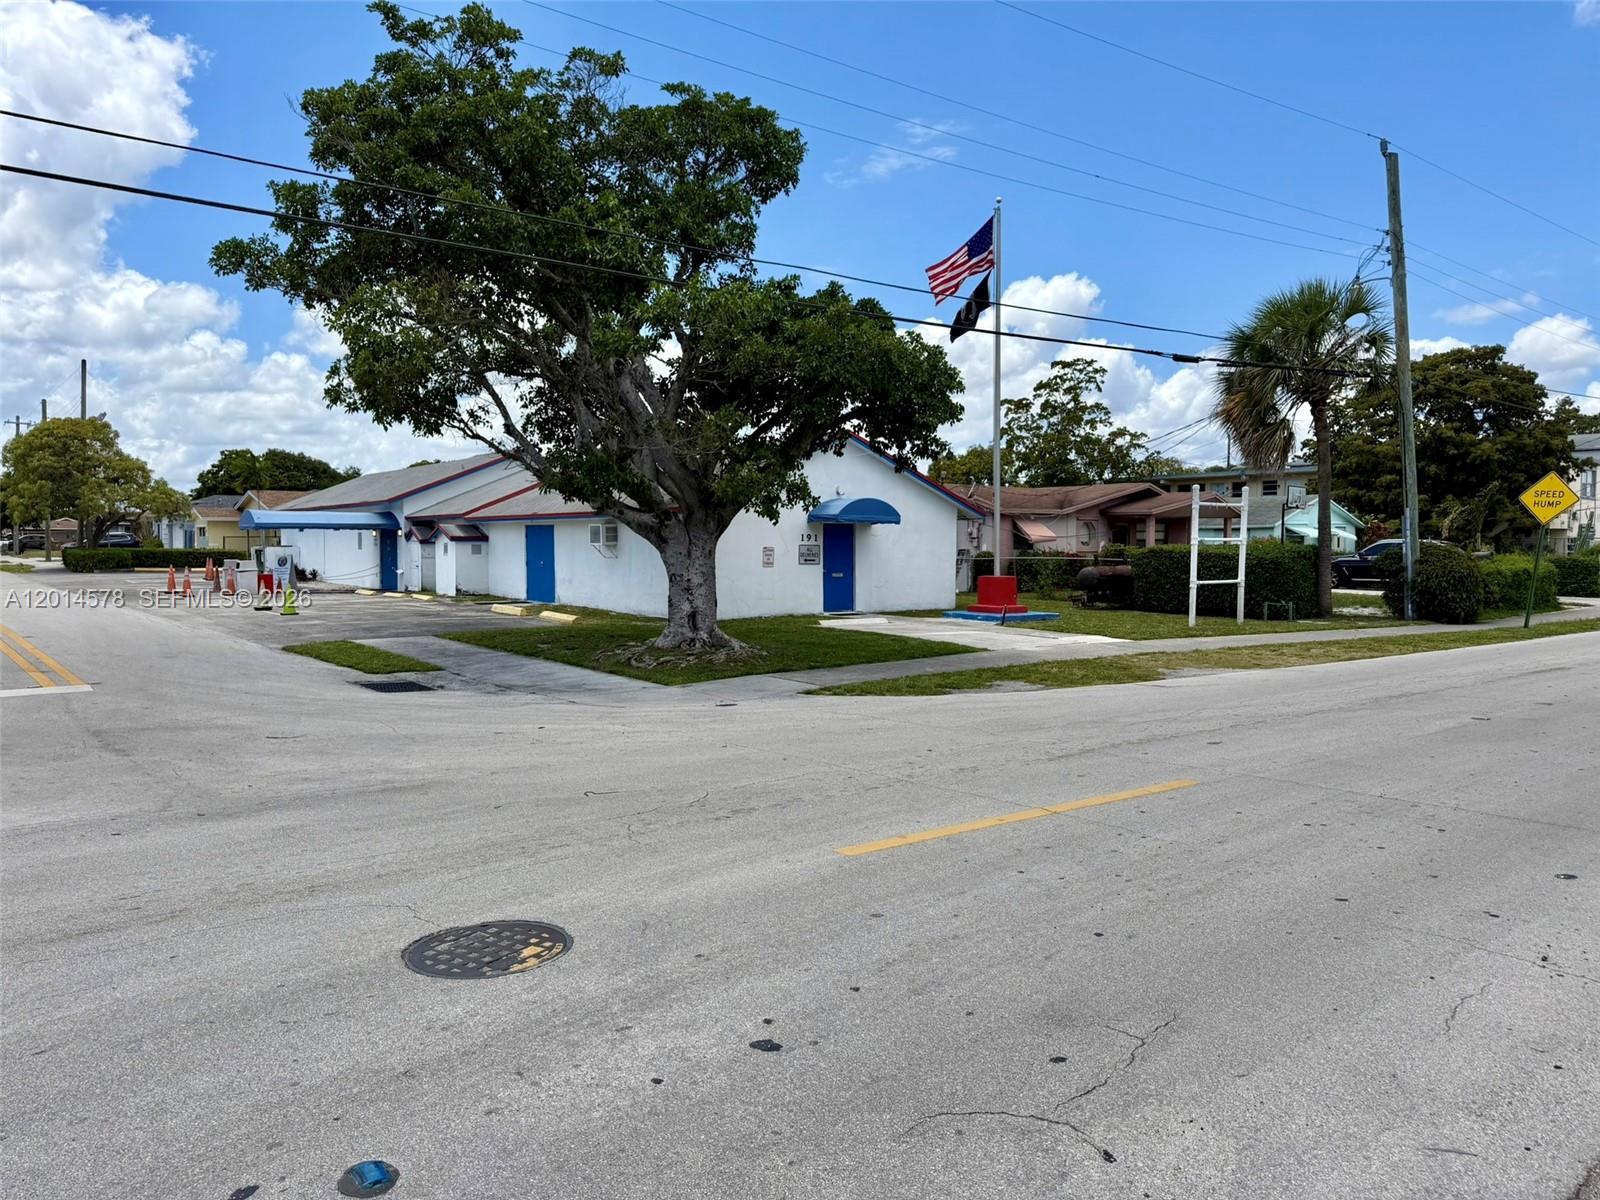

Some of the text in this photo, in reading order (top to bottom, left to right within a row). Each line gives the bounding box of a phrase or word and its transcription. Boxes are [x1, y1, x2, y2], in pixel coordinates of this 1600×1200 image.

[1534, 490, 1565, 498] SPEED
[1533, 500, 1561, 508] HUMP
[801, 533, 818, 542] 191
